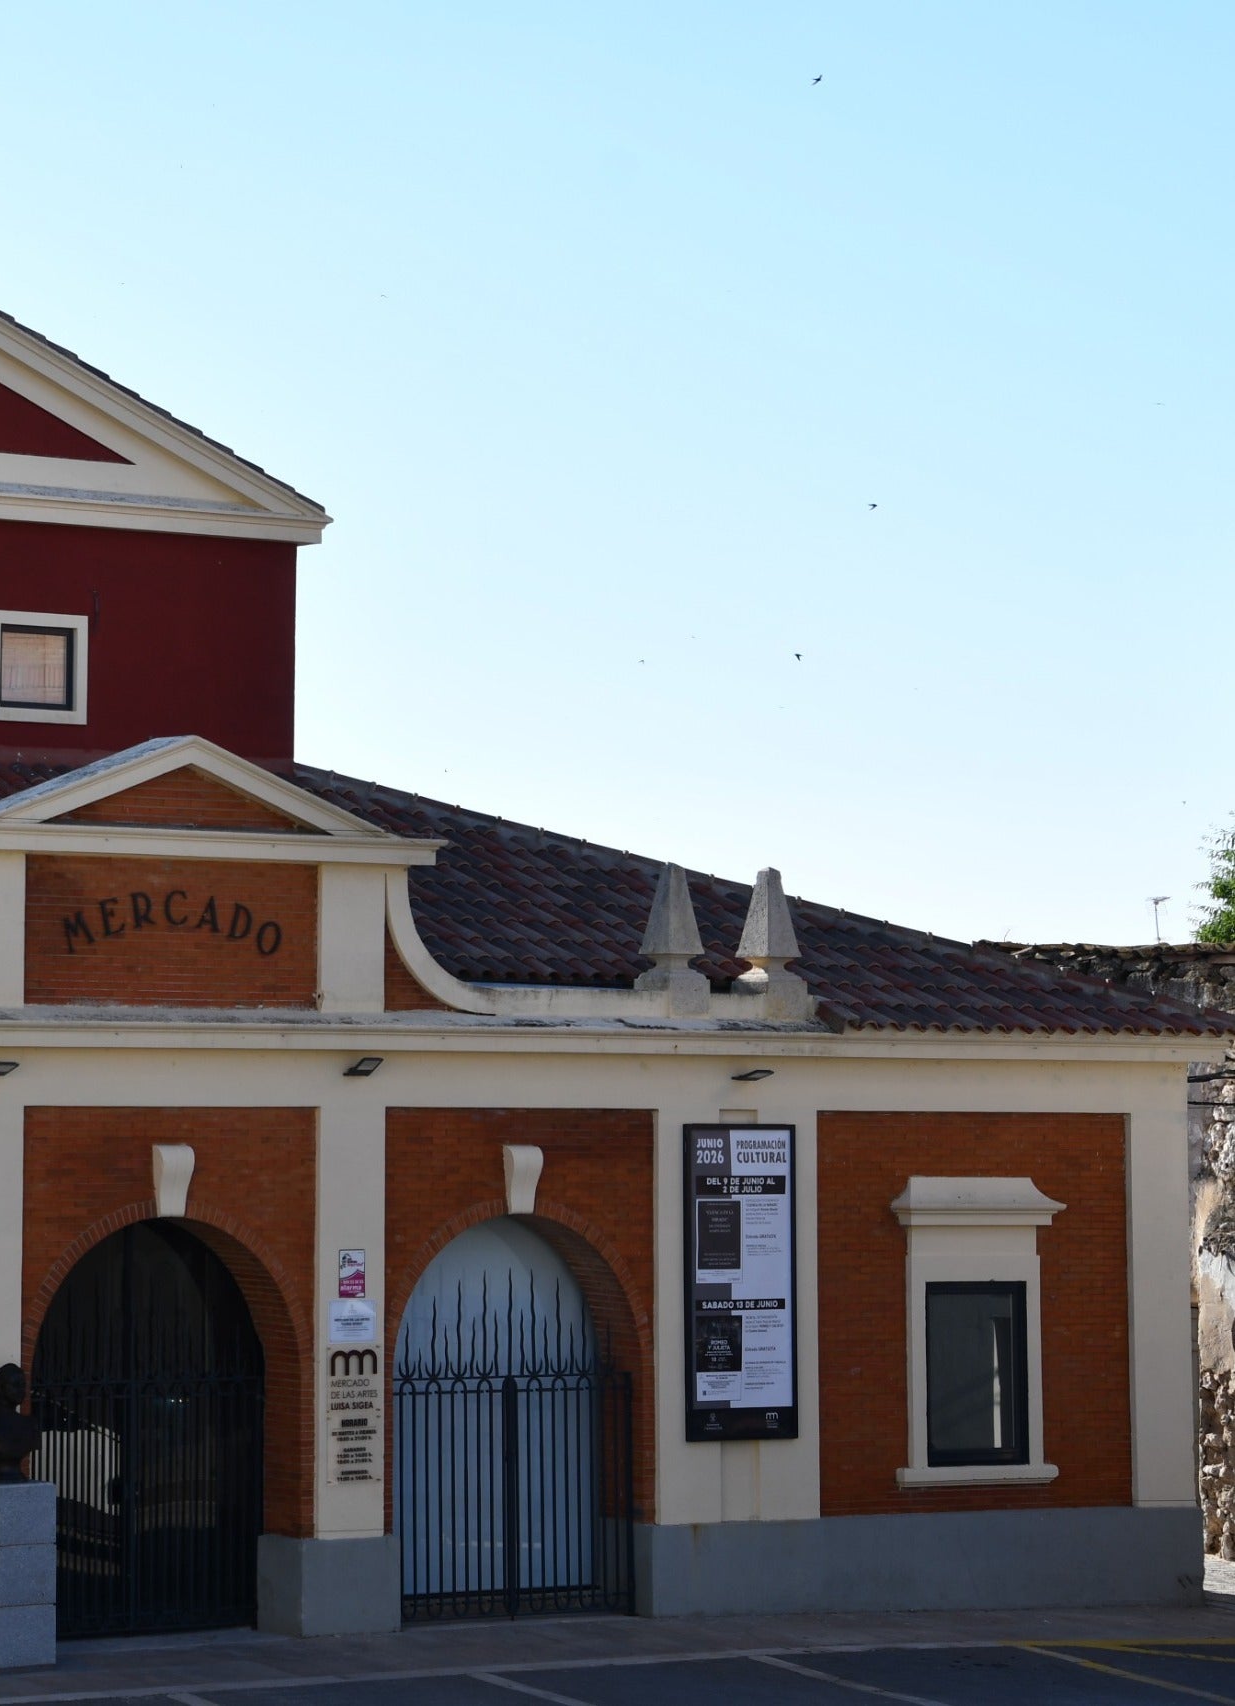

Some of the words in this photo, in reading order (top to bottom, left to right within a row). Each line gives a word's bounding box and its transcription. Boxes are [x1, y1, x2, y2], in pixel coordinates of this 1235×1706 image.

[62, 890, 283, 956] MERCADO
[696, 1138, 724, 1148] JUNIO
[736, 1138, 786, 1150] PROGRAMACIÓN
[696, 1150, 724, 1164] 2026
[736, 1151, 787, 1163] CULTURAL
[706, 1177, 721, 1185] DEL
[723, 1177, 728, 1185] 9
[730, 1177, 740, 1185] DE
[742, 1177, 764, 1185] JUNIO
[702, 1301, 734, 1309] SABADO
[736, 1301, 744, 1309] 13
[757, 1300, 778, 1308] JUNIO
[331, 1378, 370, 1387] MERCADO
[331, 1391, 340, 1399] DE
[342, 1390, 355, 1399] LAS
[357, 1389, 378, 1398] ARTES
[331, 1402, 350, 1410] LUISA
[352, 1401, 374, 1409] SIGEA
